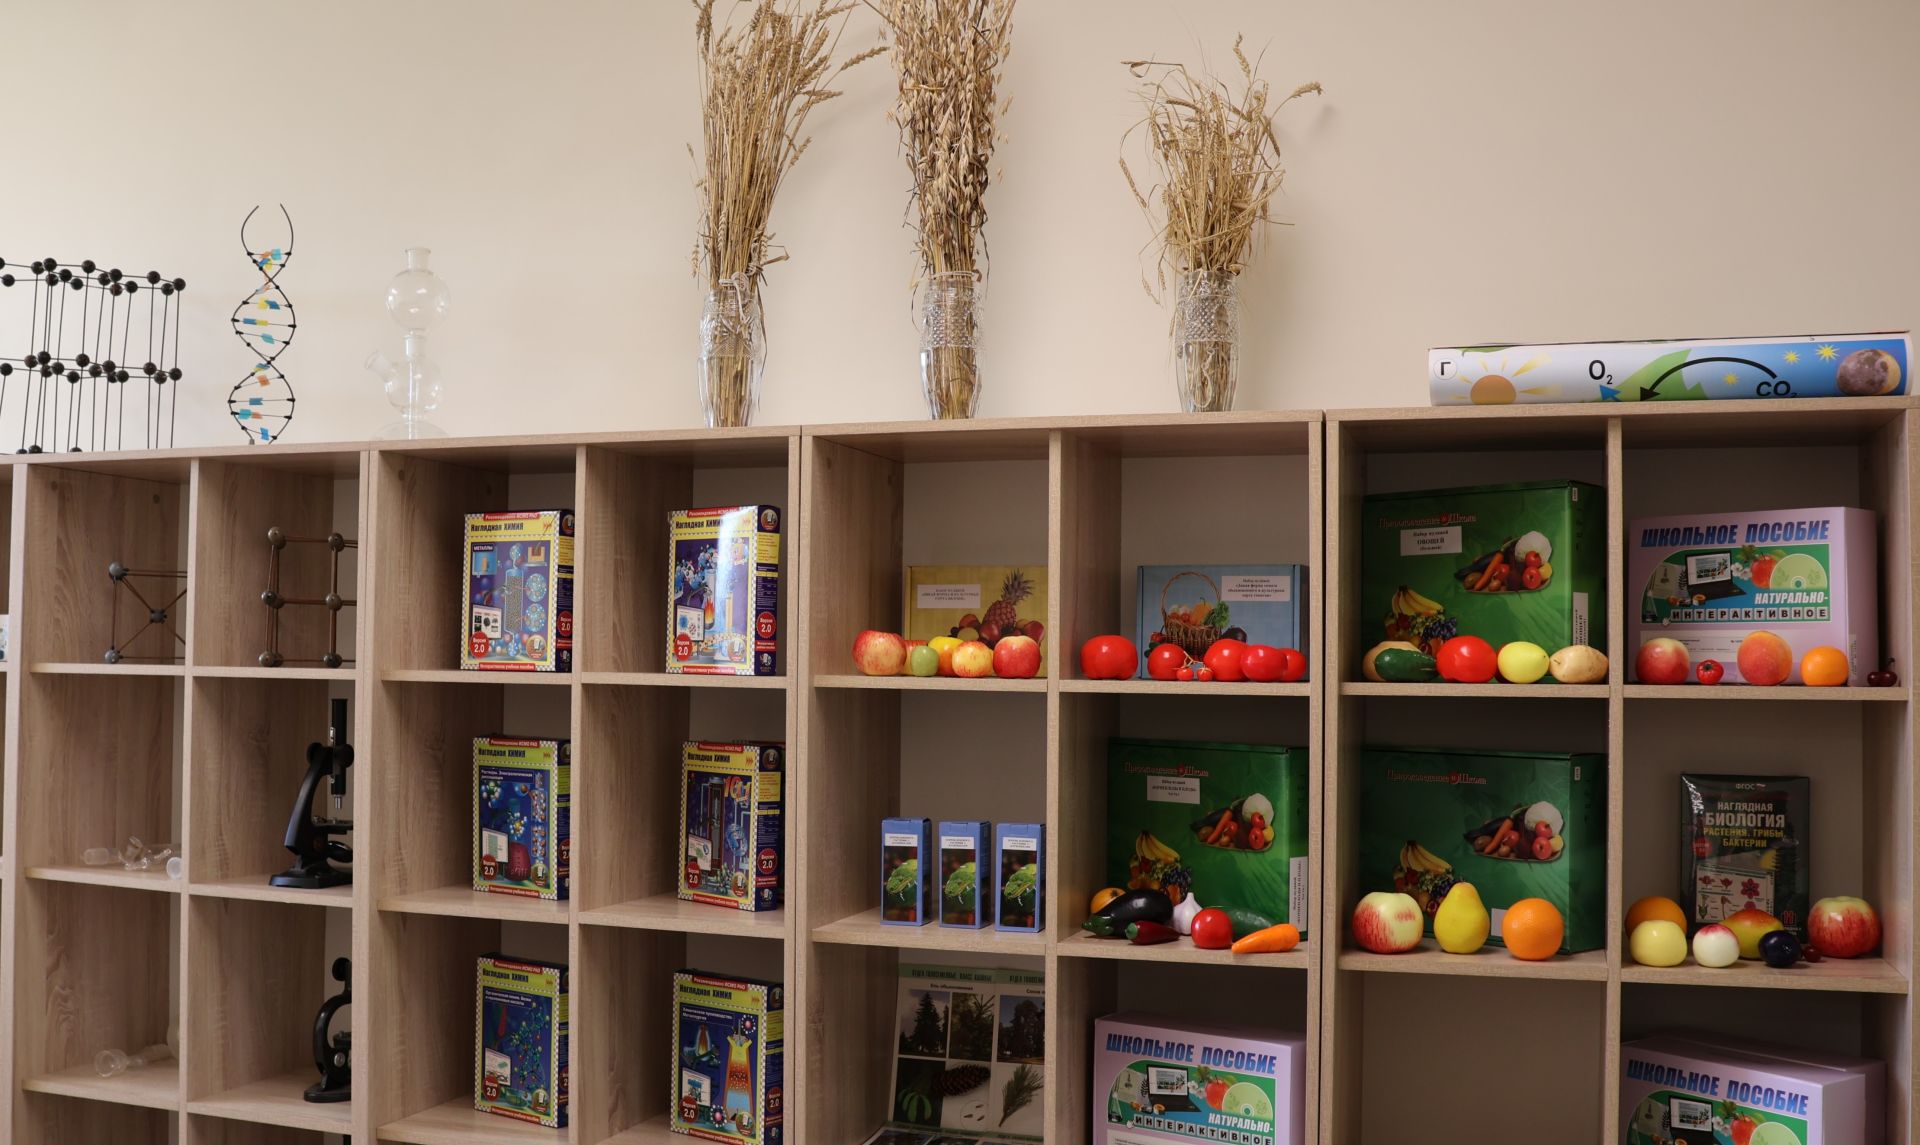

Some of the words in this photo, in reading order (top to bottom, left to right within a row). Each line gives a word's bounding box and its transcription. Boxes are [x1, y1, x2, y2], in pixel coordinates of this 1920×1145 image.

[1441, 361, 1451, 376] Г
[471, 524, 502, 532] Наглядная
[503, 522, 524, 531] ХИМИЯ
[675, 520, 704, 530] Наглядная
[705, 518, 722, 528] ХИМИ
[1641, 524, 1739, 548] ШКОЛЬНОЕ
[1745, 520, 1830, 543] ПОСОБИЕ
[1754, 591, 1829, 605] НАТУРАЛЬНО-
[1673, 608, 1827, 621] ИНТЕРАКТИВНОЕ
[561, 622, 571, 631] 2.0
[761, 624, 772, 633] 2.0
[474, 644, 485, 653] 2.0
[678, 646, 689, 656] 2.0
[508, 750, 526, 758] ХИМИЯ
[1717, 801, 1774, 812] НАГЛЯДНАЯ
[1705, 812, 1786, 828] БИОЛОГИЯ
[1722, 838, 1768, 848] БАКТЕРИИ
[762, 860, 773, 869] 2.0
[484, 866, 494, 876] 2.0
[689, 874, 698, 884] 2.0
[680, 984, 711, 997] Наглядная
[712, 989, 732, 1000] ХИМИЯ
[1106, 1033, 1195, 1063] ШКОЛЬНОЕ
[1200, 1046, 1278, 1075] ПОСОБИЕ
[486, 1088, 497, 1097] 2.0
[1626, 1059, 1721, 1096] ШКОЛЬНОЕ
[1726, 1079, 1809, 1116] ПОСОБИЕ
[769, 1098, 780, 1108] 2.0
[684, 1109, 695, 1119] 2.0
[1208, 1113, 1274, 1133] НАТУРАЛЬНО-
[1135, 1115, 1272, 1145] ИНТЕРАКТИВНОЕ
